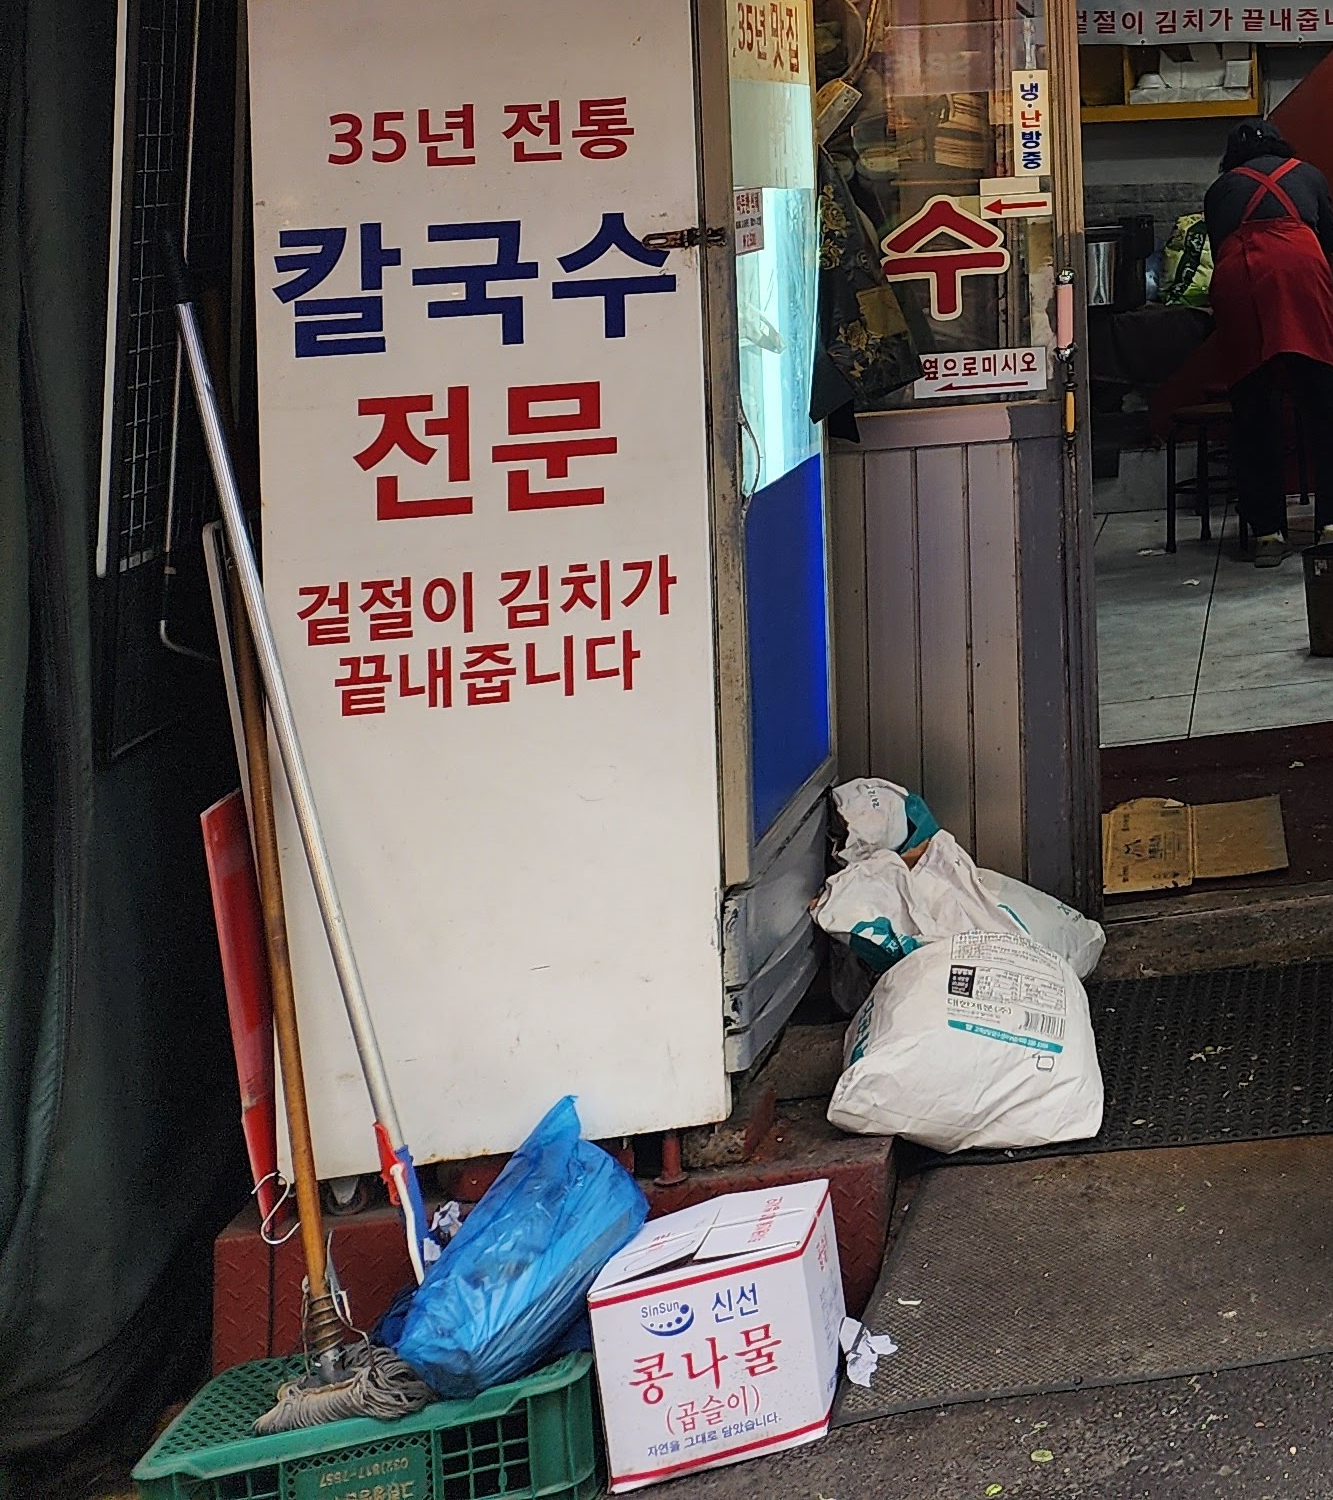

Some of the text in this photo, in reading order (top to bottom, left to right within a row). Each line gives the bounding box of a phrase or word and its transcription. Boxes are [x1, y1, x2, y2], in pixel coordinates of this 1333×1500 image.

[737, 2, 767, 61] 35년
[1155, 7, 1233, 34] 김치가
[327, 98, 636, 167] 35년 전통
[272, 212, 677, 358] 칼국수
[883, 200, 1004, 315] 수
[353, 381, 619, 522] 전문
[297, 555, 678, 647] 겉절이 김치가
[334, 631, 641, 716] 끝내줍니다
[641, 1283, 759, 1323] SinSun 신선
[629, 1324, 781, 1404] 콩나물
[648, 1440, 680, 1457] 자연을
[684, 1430, 718, 1448] 그대로
[666, 1385, 761, 1434] (곱슬이)
